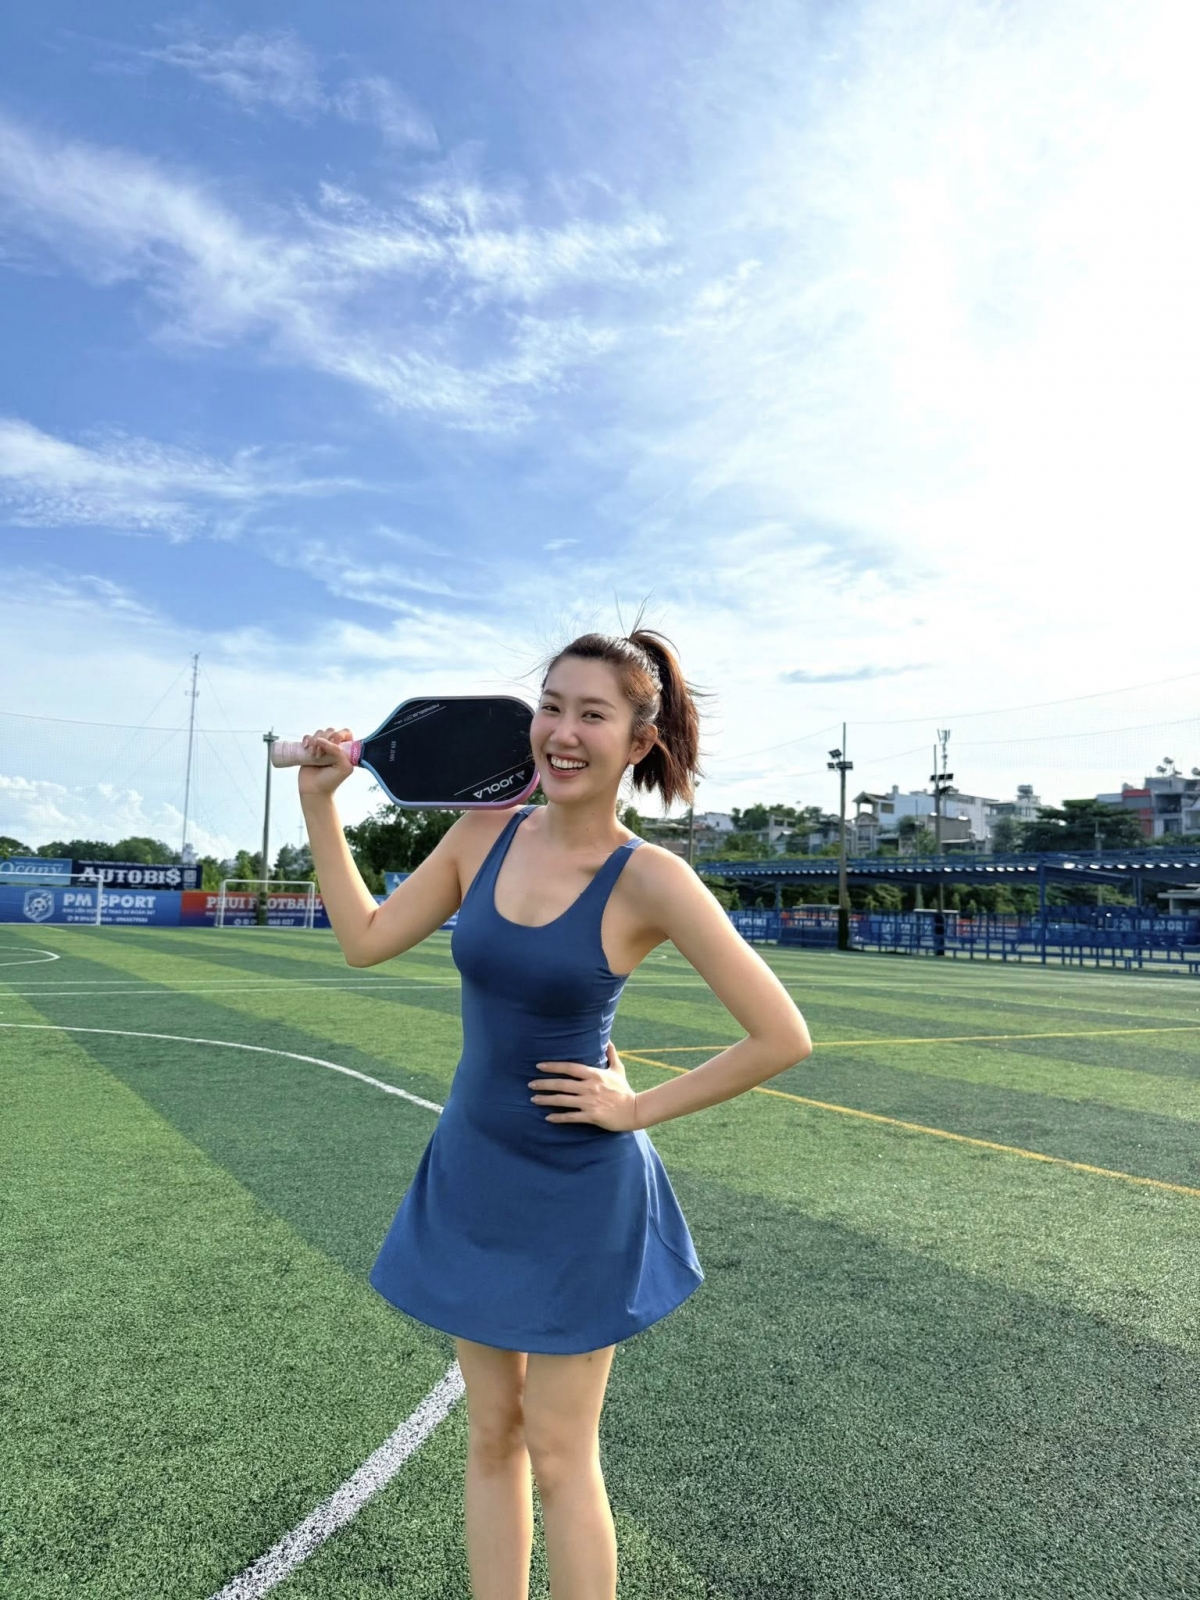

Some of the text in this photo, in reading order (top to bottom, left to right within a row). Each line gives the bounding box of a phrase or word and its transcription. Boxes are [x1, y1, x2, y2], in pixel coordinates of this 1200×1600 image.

[473, 775, 514, 799] JOOLA
[63, 893, 156, 908] PM SPORT
